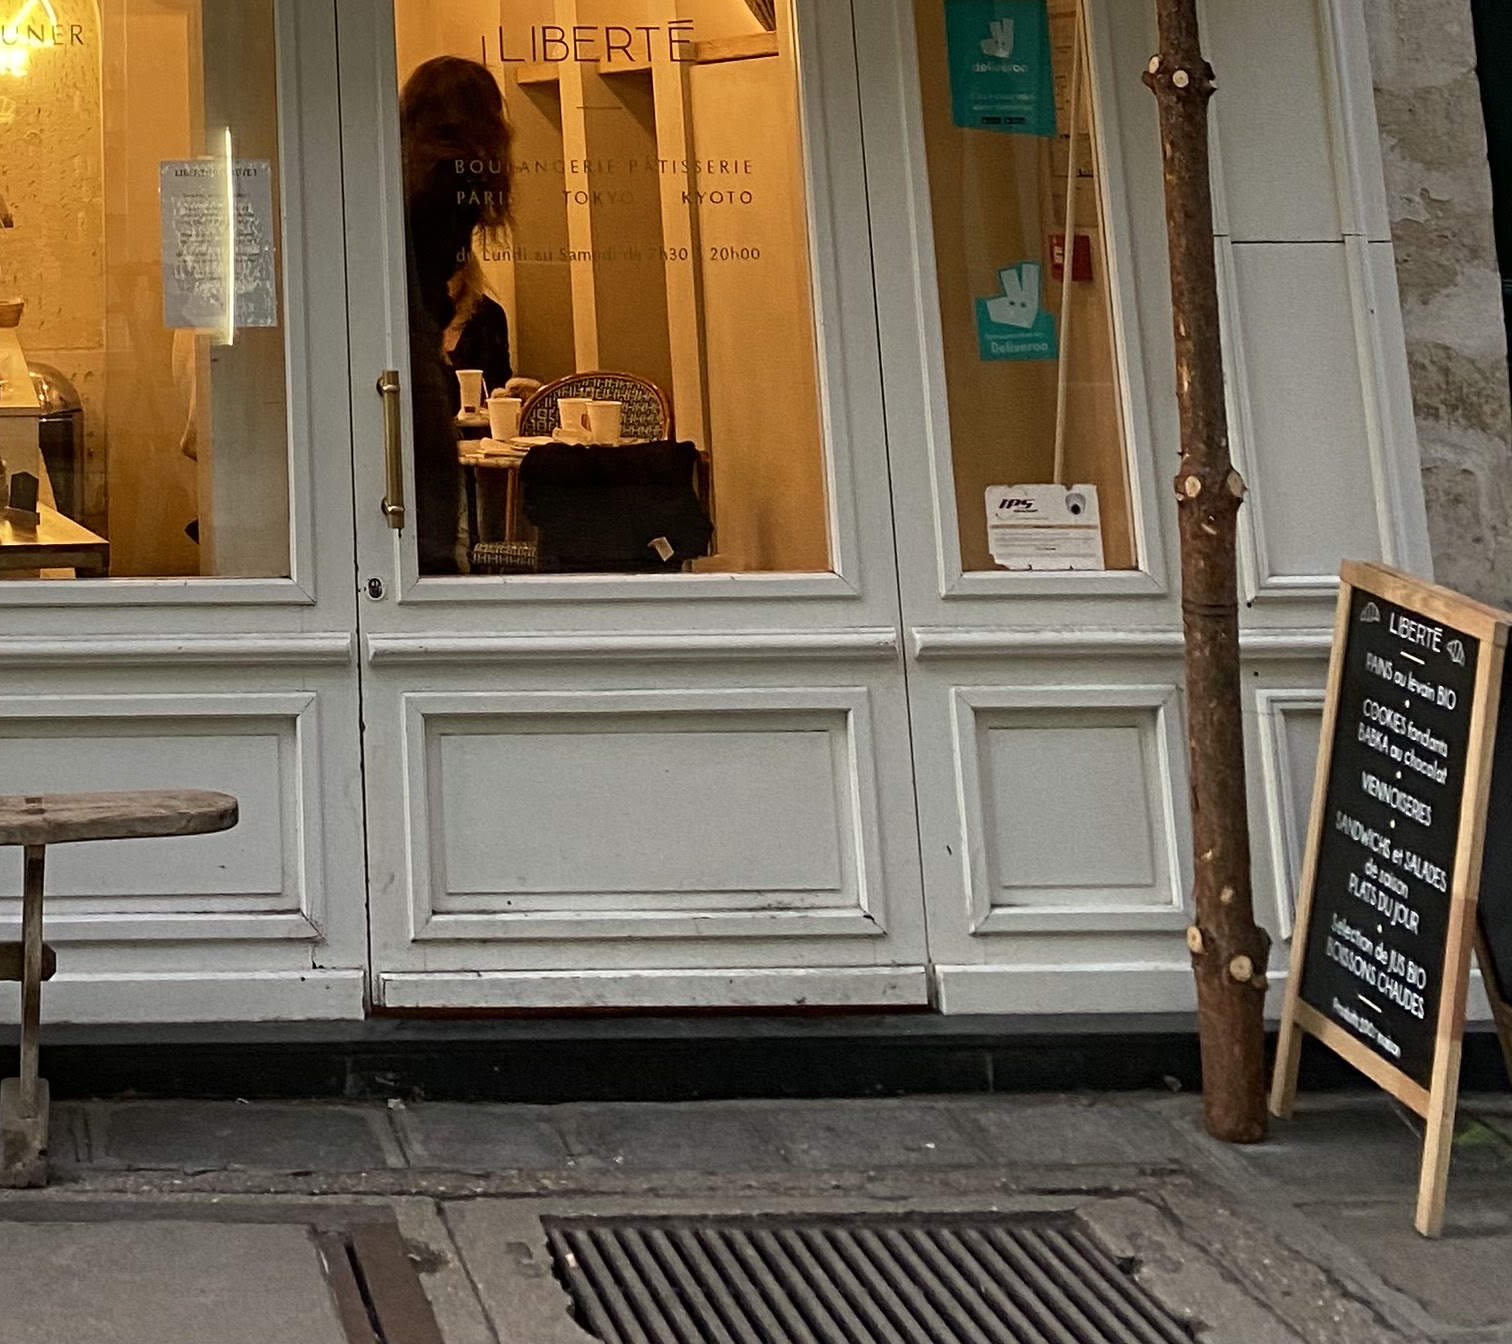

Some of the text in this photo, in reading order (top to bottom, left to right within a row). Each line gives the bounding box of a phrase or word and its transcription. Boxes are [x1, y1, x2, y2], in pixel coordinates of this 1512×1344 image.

[498, 19, 694, 63] LIBERTÉ
[454, 159, 616, 174] BOULANGERIE
[456, 190, 753, 205] PARIS TOKYO KYOTO
[482, 246, 527, 261] Lundi
[710, 246, 761, 261] 20h00
[991, 341, 1048, 354] Deliveroo
[1389, 612, 1443, 653] LIBERTÉ
[1366, 652, 1457, 710] PAINS au levain BIO
[1363, 698, 1448, 758] COOKIES fondants
[1358, 722, 1448, 784] BABKA au chocolat
[1361, 771, 1432, 826] VIENNOISERIES
[1364, 858, 1378, 879] de
[1404, 851, 1447, 892] SALADES
[1348, 872, 1420, 934] PLATS DU JOUR
[1326, 935, 1424, 1020] BOISSONS CHAUDES
[1375, 942, 1388, 965] de
[1387, 949, 1406, 977] JUS
[1406, 960, 1427, 990] BIO
